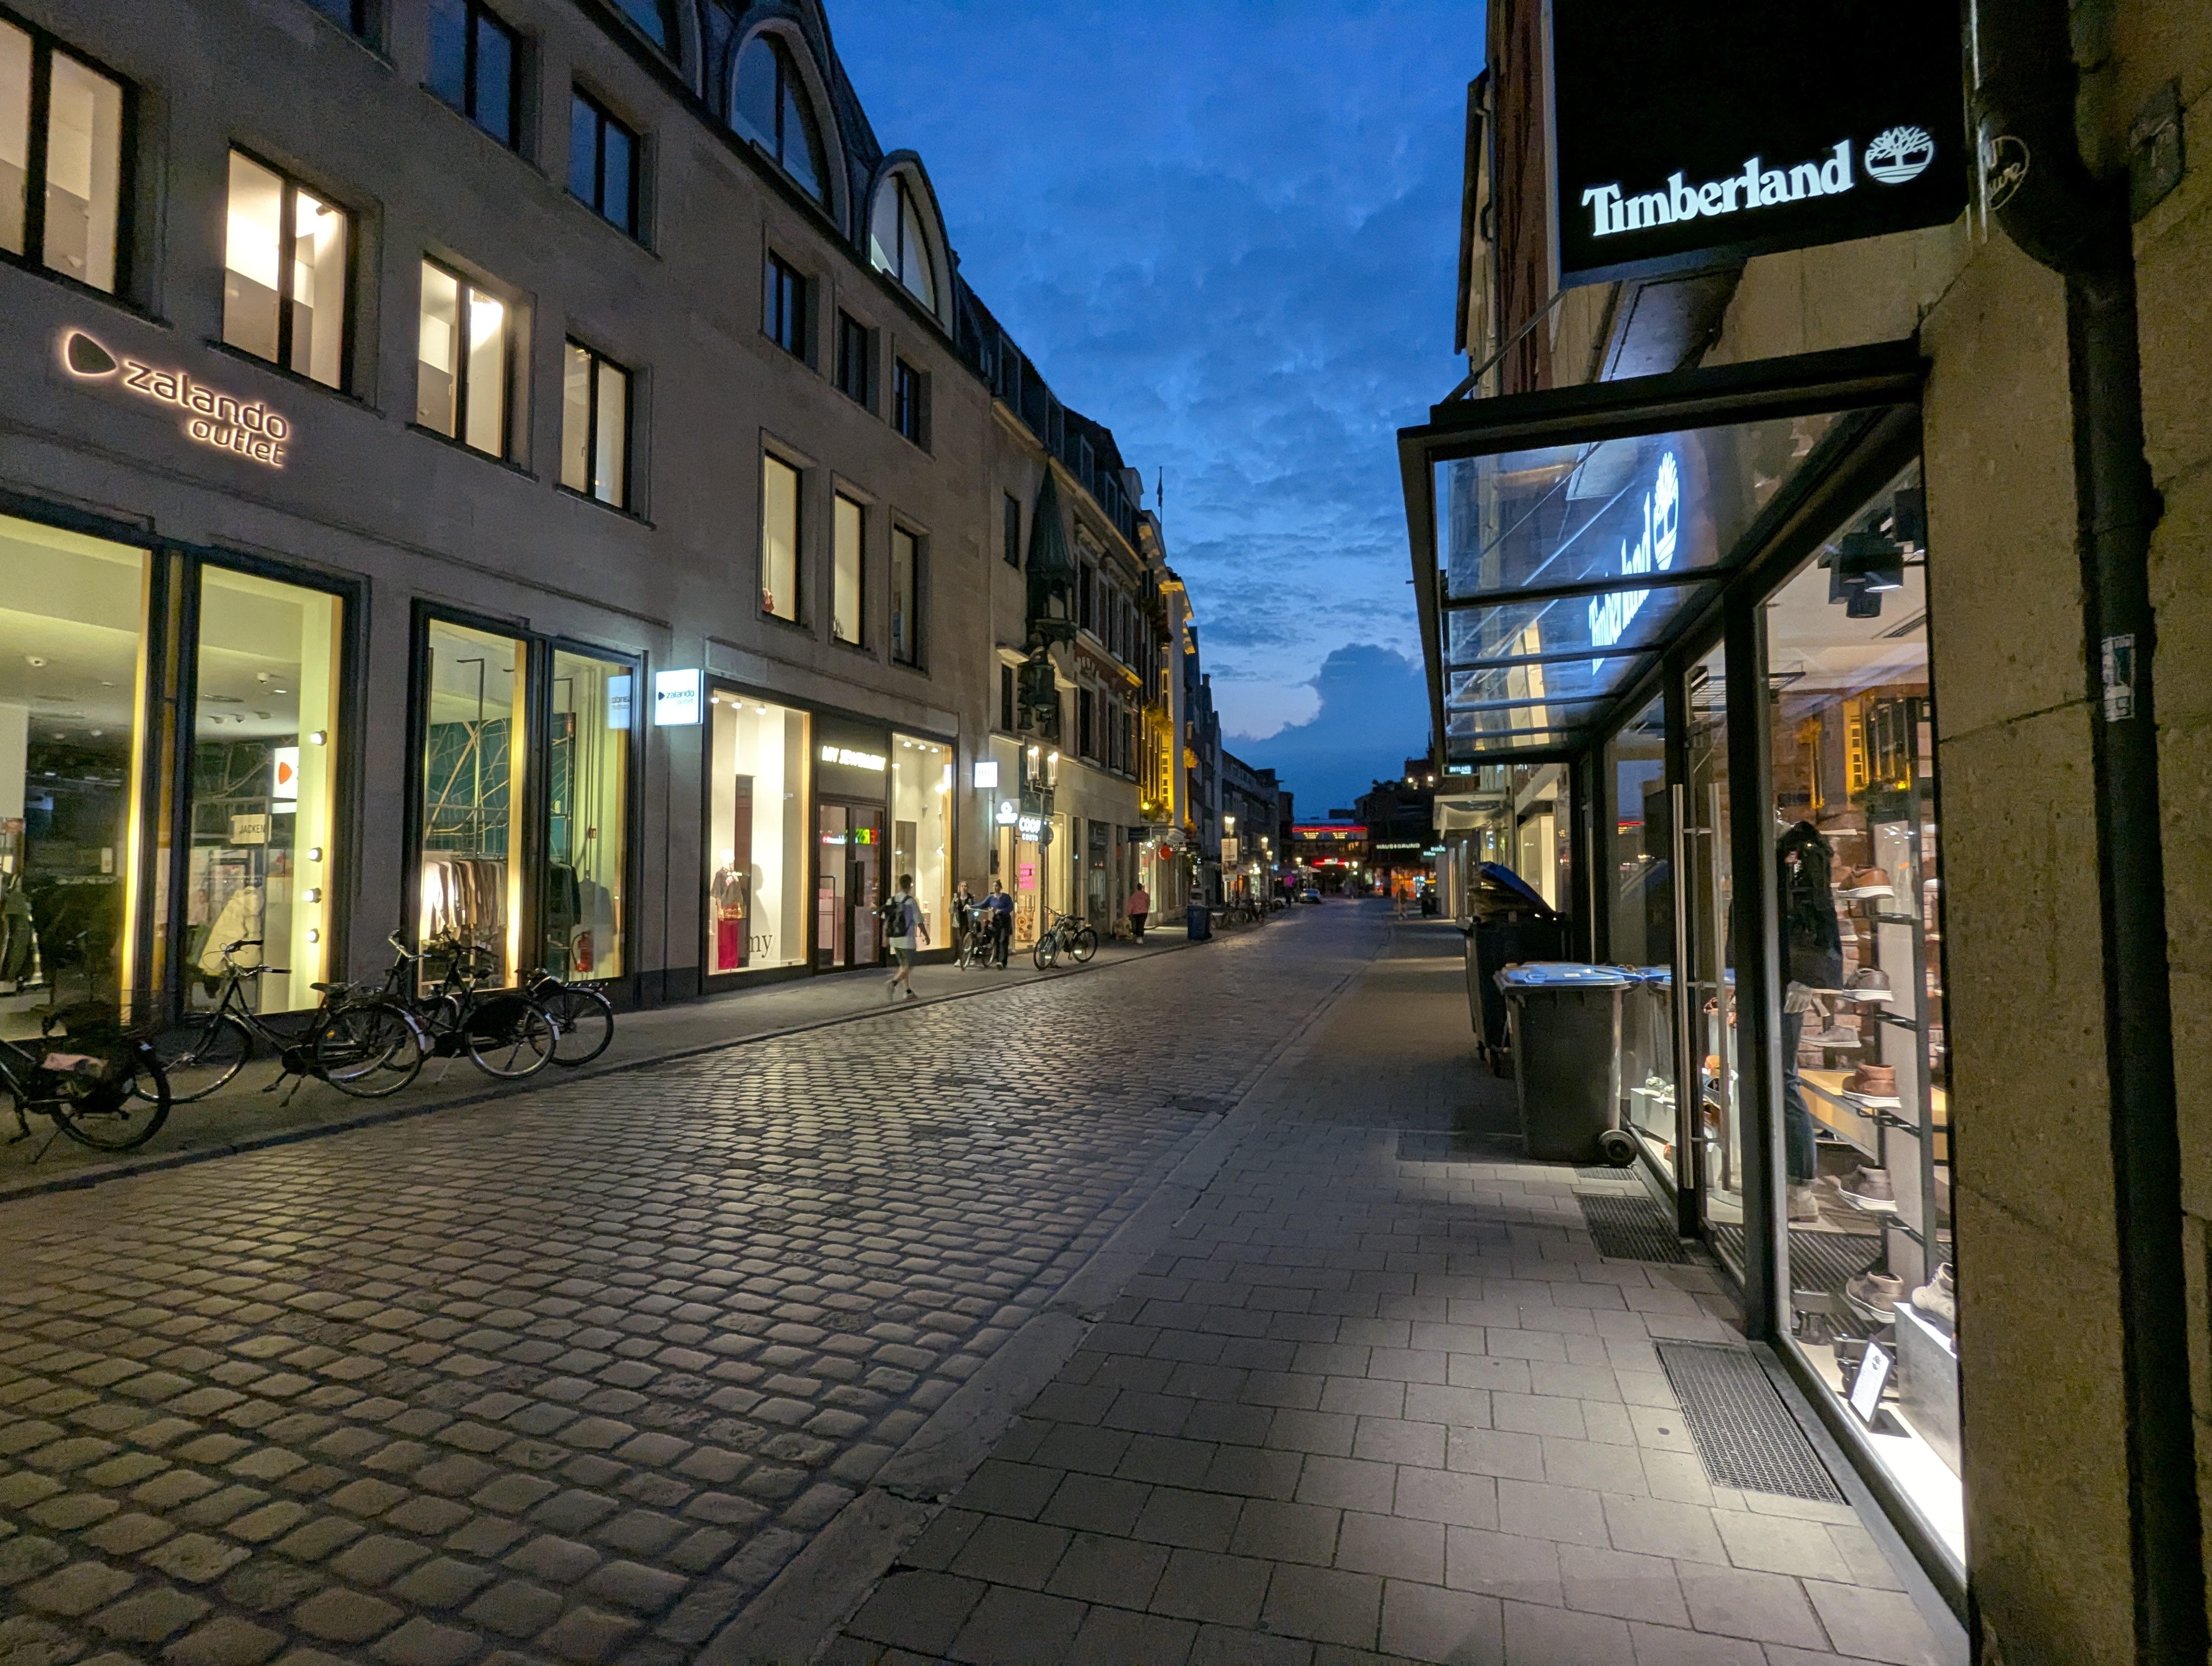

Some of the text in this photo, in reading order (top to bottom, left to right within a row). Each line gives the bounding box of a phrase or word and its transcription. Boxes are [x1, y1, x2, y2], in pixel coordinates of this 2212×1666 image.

[1581, 139, 1854, 236] Timberland
[126, 360, 288, 439] zalando
[191, 420, 285, 465] outlet
[666, 689, 695, 699] zalando
